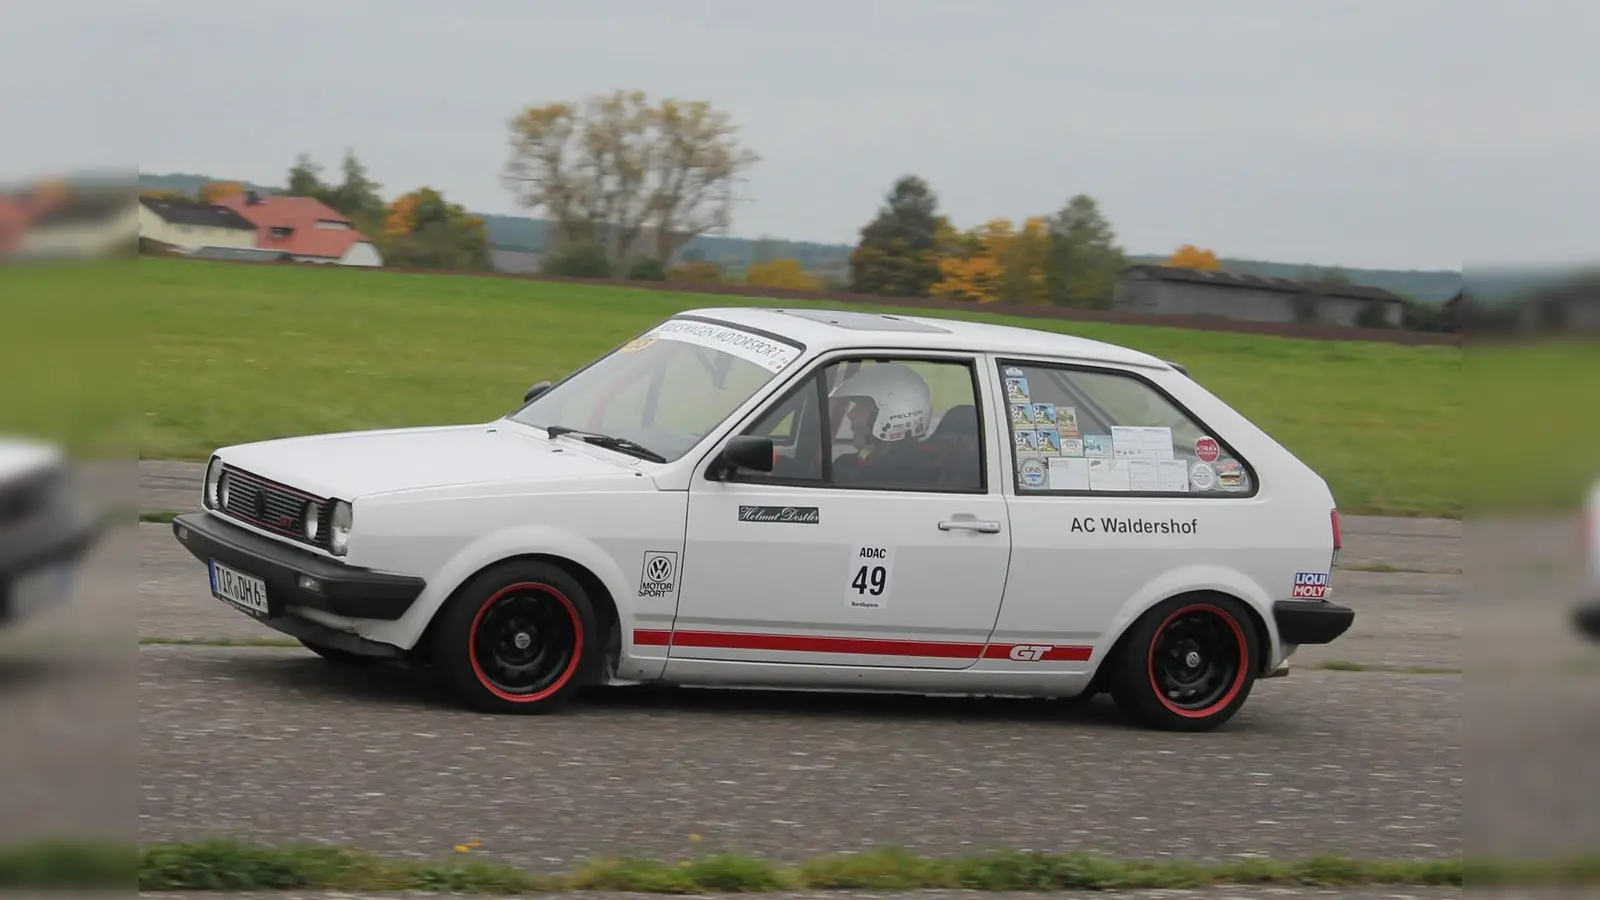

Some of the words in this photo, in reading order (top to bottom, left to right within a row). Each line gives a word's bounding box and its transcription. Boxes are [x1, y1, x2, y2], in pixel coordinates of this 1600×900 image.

[714, 329, 785, 359] MOTORSPORT
[740, 506, 780, 521] Helmut
[1071, 517, 1096, 533] AC
[1100, 517, 1198, 534] Waldershof
[859, 547, 887, 559] ADAC
[215, 565, 235, 598] TIR
[642, 582, 672, 590] MOTOR
[851, 565, 887, 596] 49
[1296, 573, 1327, 585] LIQUI
[1293, 585, 1325, 597] MOLY
[1009, 645, 1053, 661] GT
